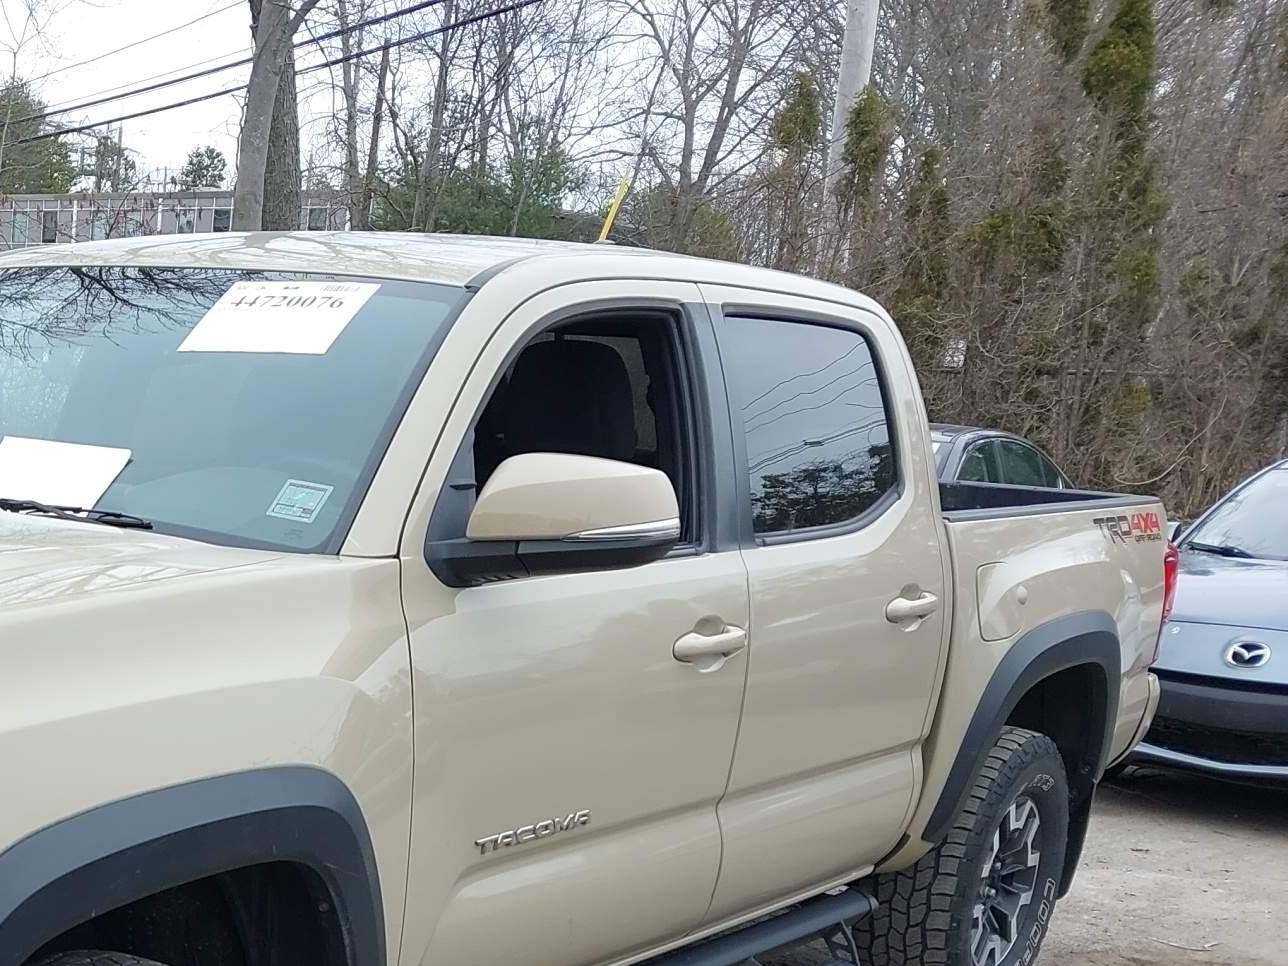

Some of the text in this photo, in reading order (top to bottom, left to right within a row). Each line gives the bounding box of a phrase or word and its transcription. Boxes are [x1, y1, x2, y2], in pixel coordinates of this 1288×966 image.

[230, 295, 345, 309] 44720076
[1093, 515, 1132, 544] TRD
[474, 809, 591, 855] TACOMA
